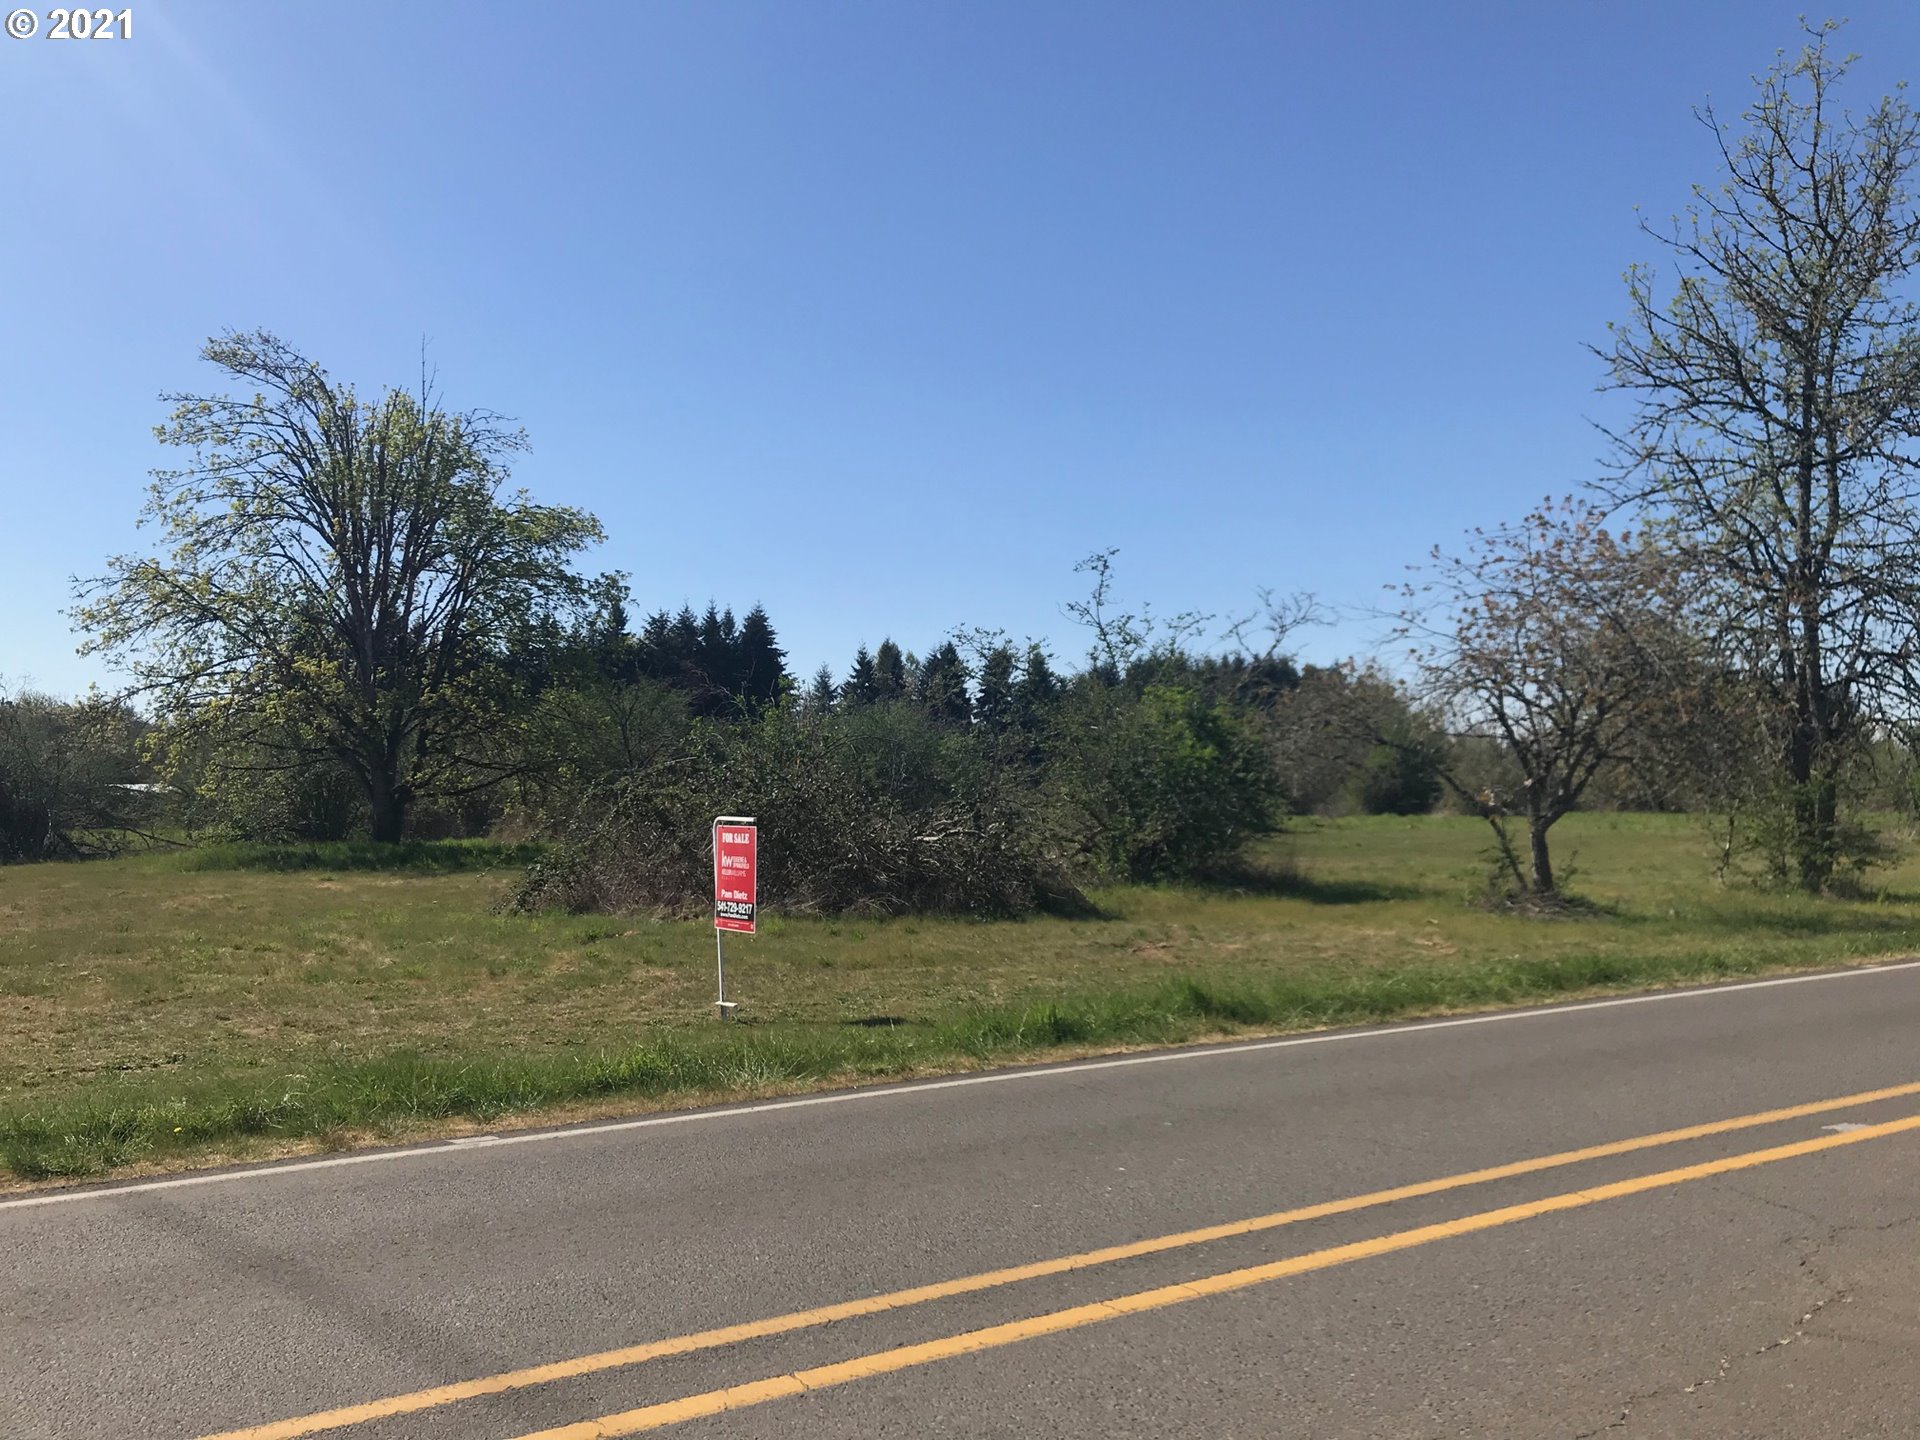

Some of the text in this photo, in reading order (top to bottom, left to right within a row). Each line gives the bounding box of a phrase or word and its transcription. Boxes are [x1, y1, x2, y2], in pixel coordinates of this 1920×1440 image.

[722, 832, 749, 844] FOR SALE
[721, 889, 748, 900] Pam Dietz
